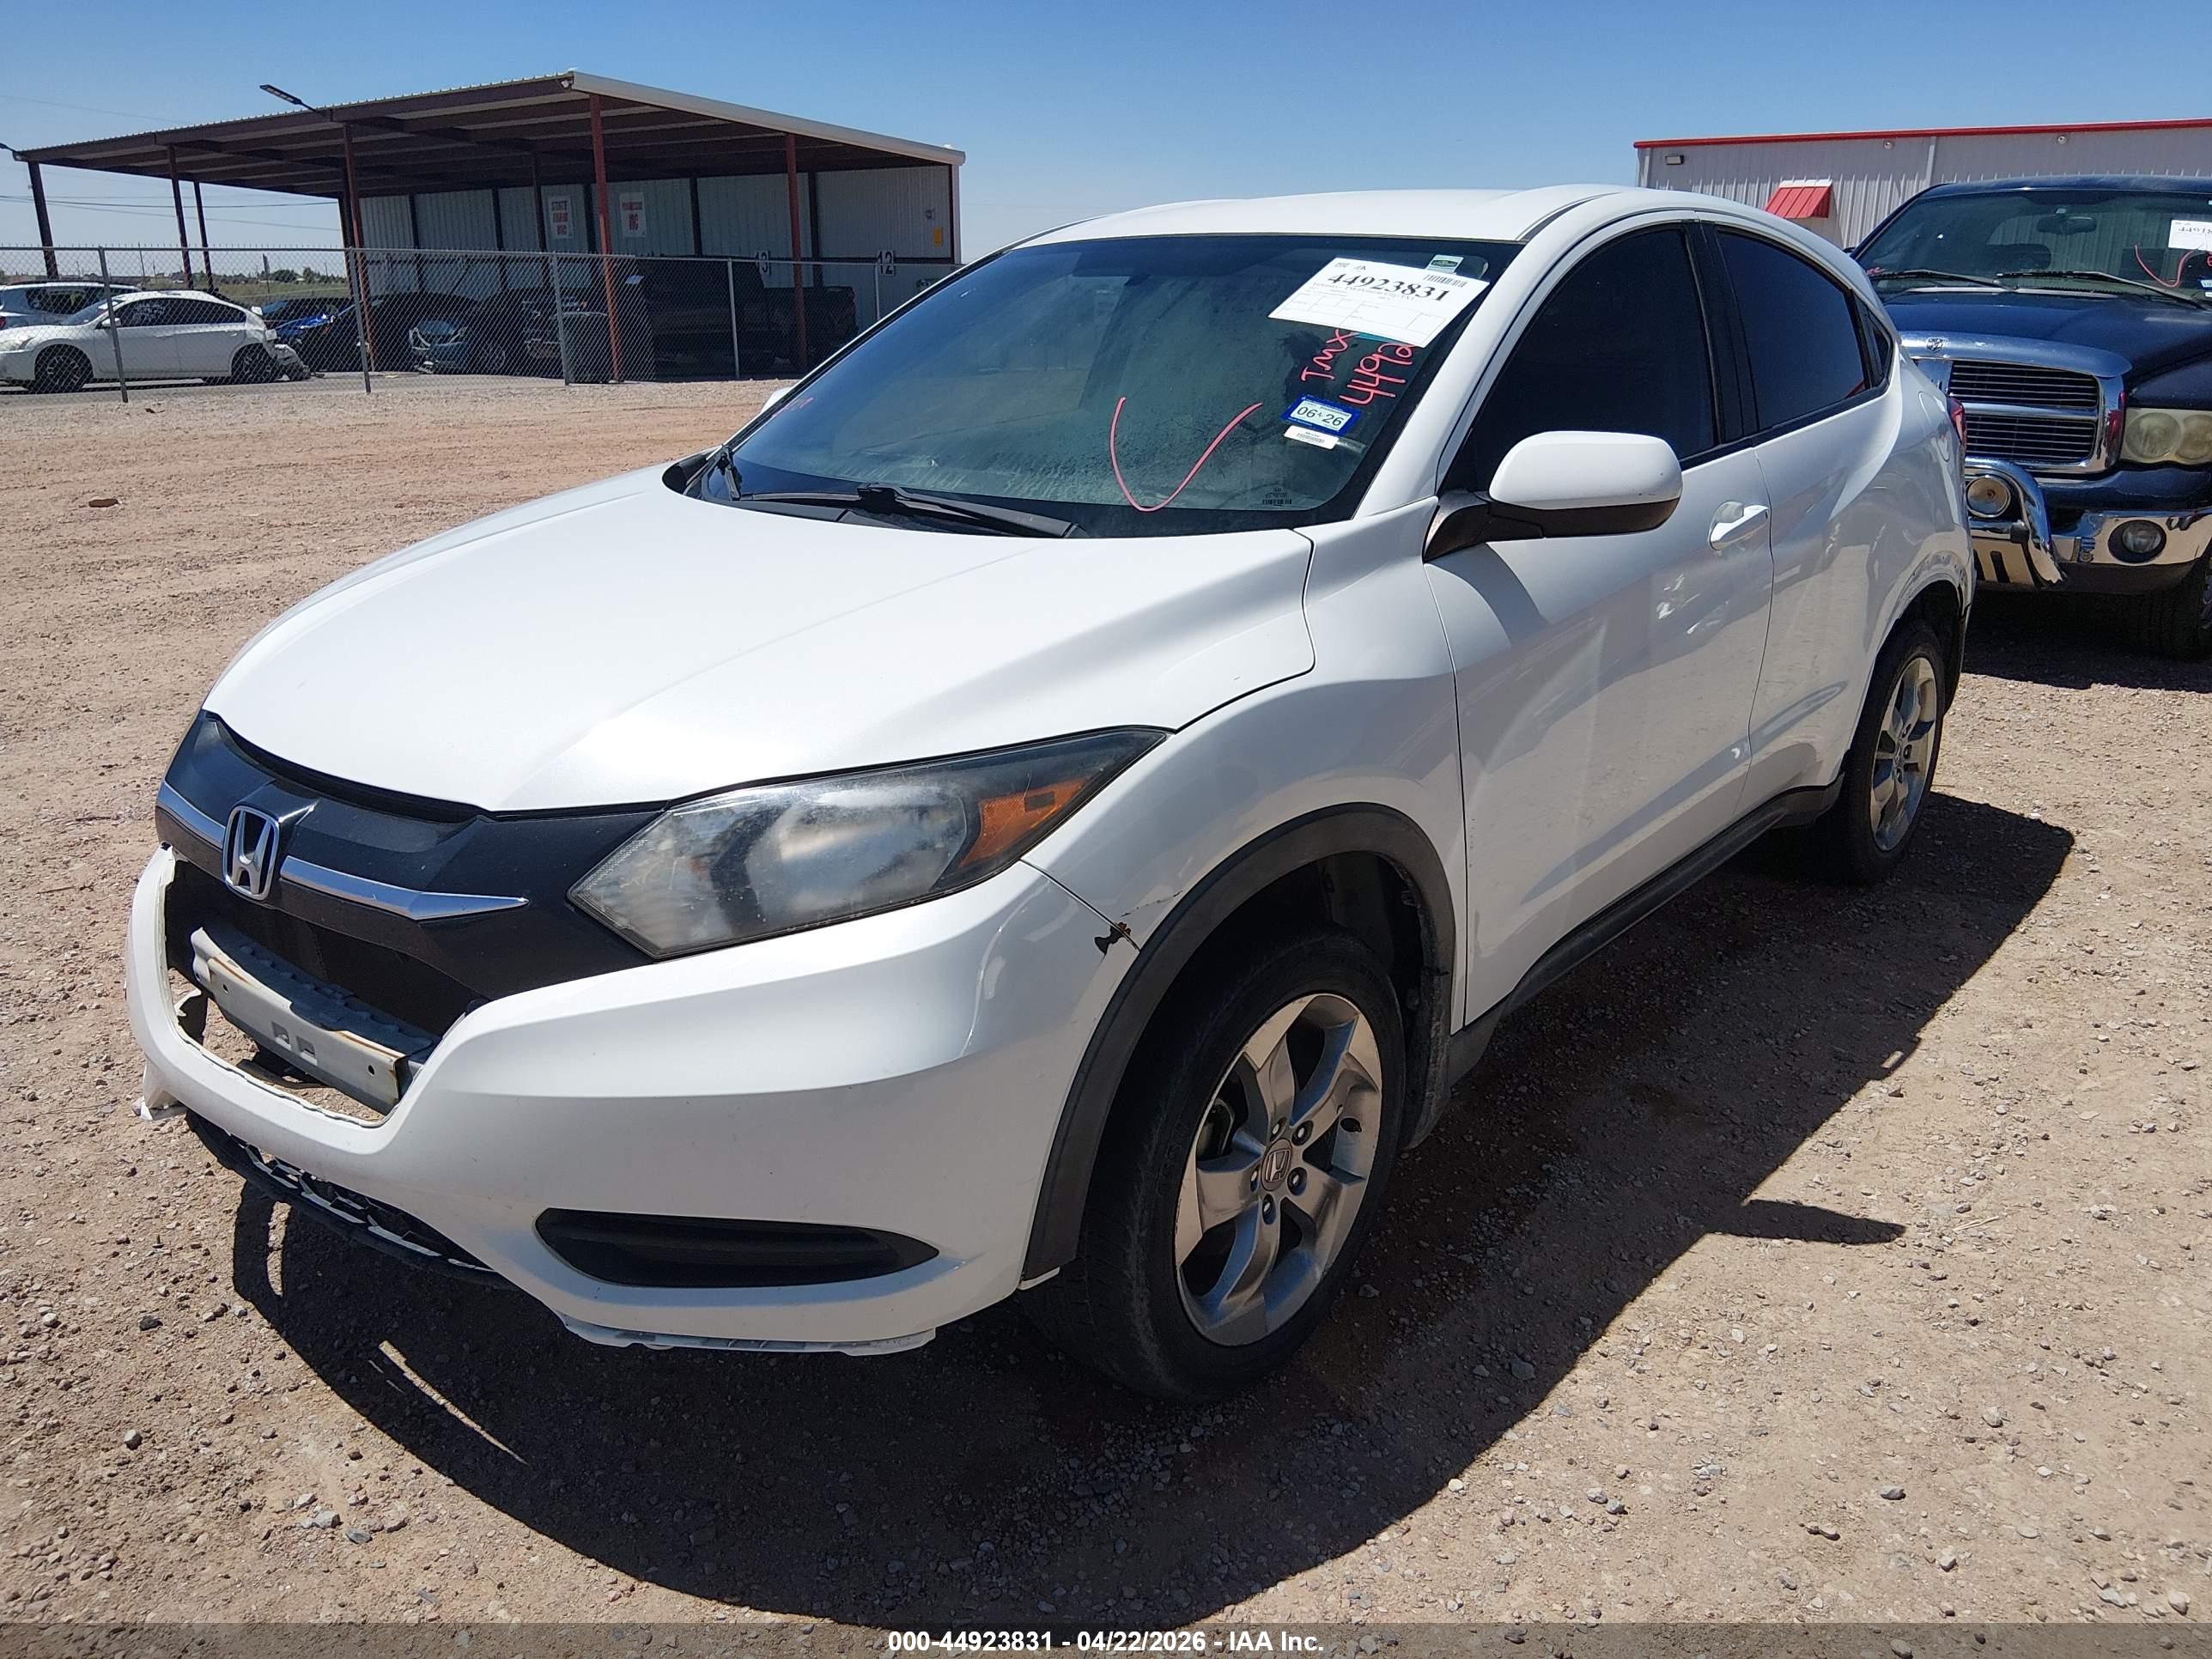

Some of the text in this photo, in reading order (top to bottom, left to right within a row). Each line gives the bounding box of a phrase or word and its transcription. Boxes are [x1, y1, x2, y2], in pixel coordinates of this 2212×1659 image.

[877, 251, 895, 275] 12
[1328, 273, 1450, 301] 44923831
[1297, 406, 1318, 418] 06
[1322, 413, 1345, 427] 26
